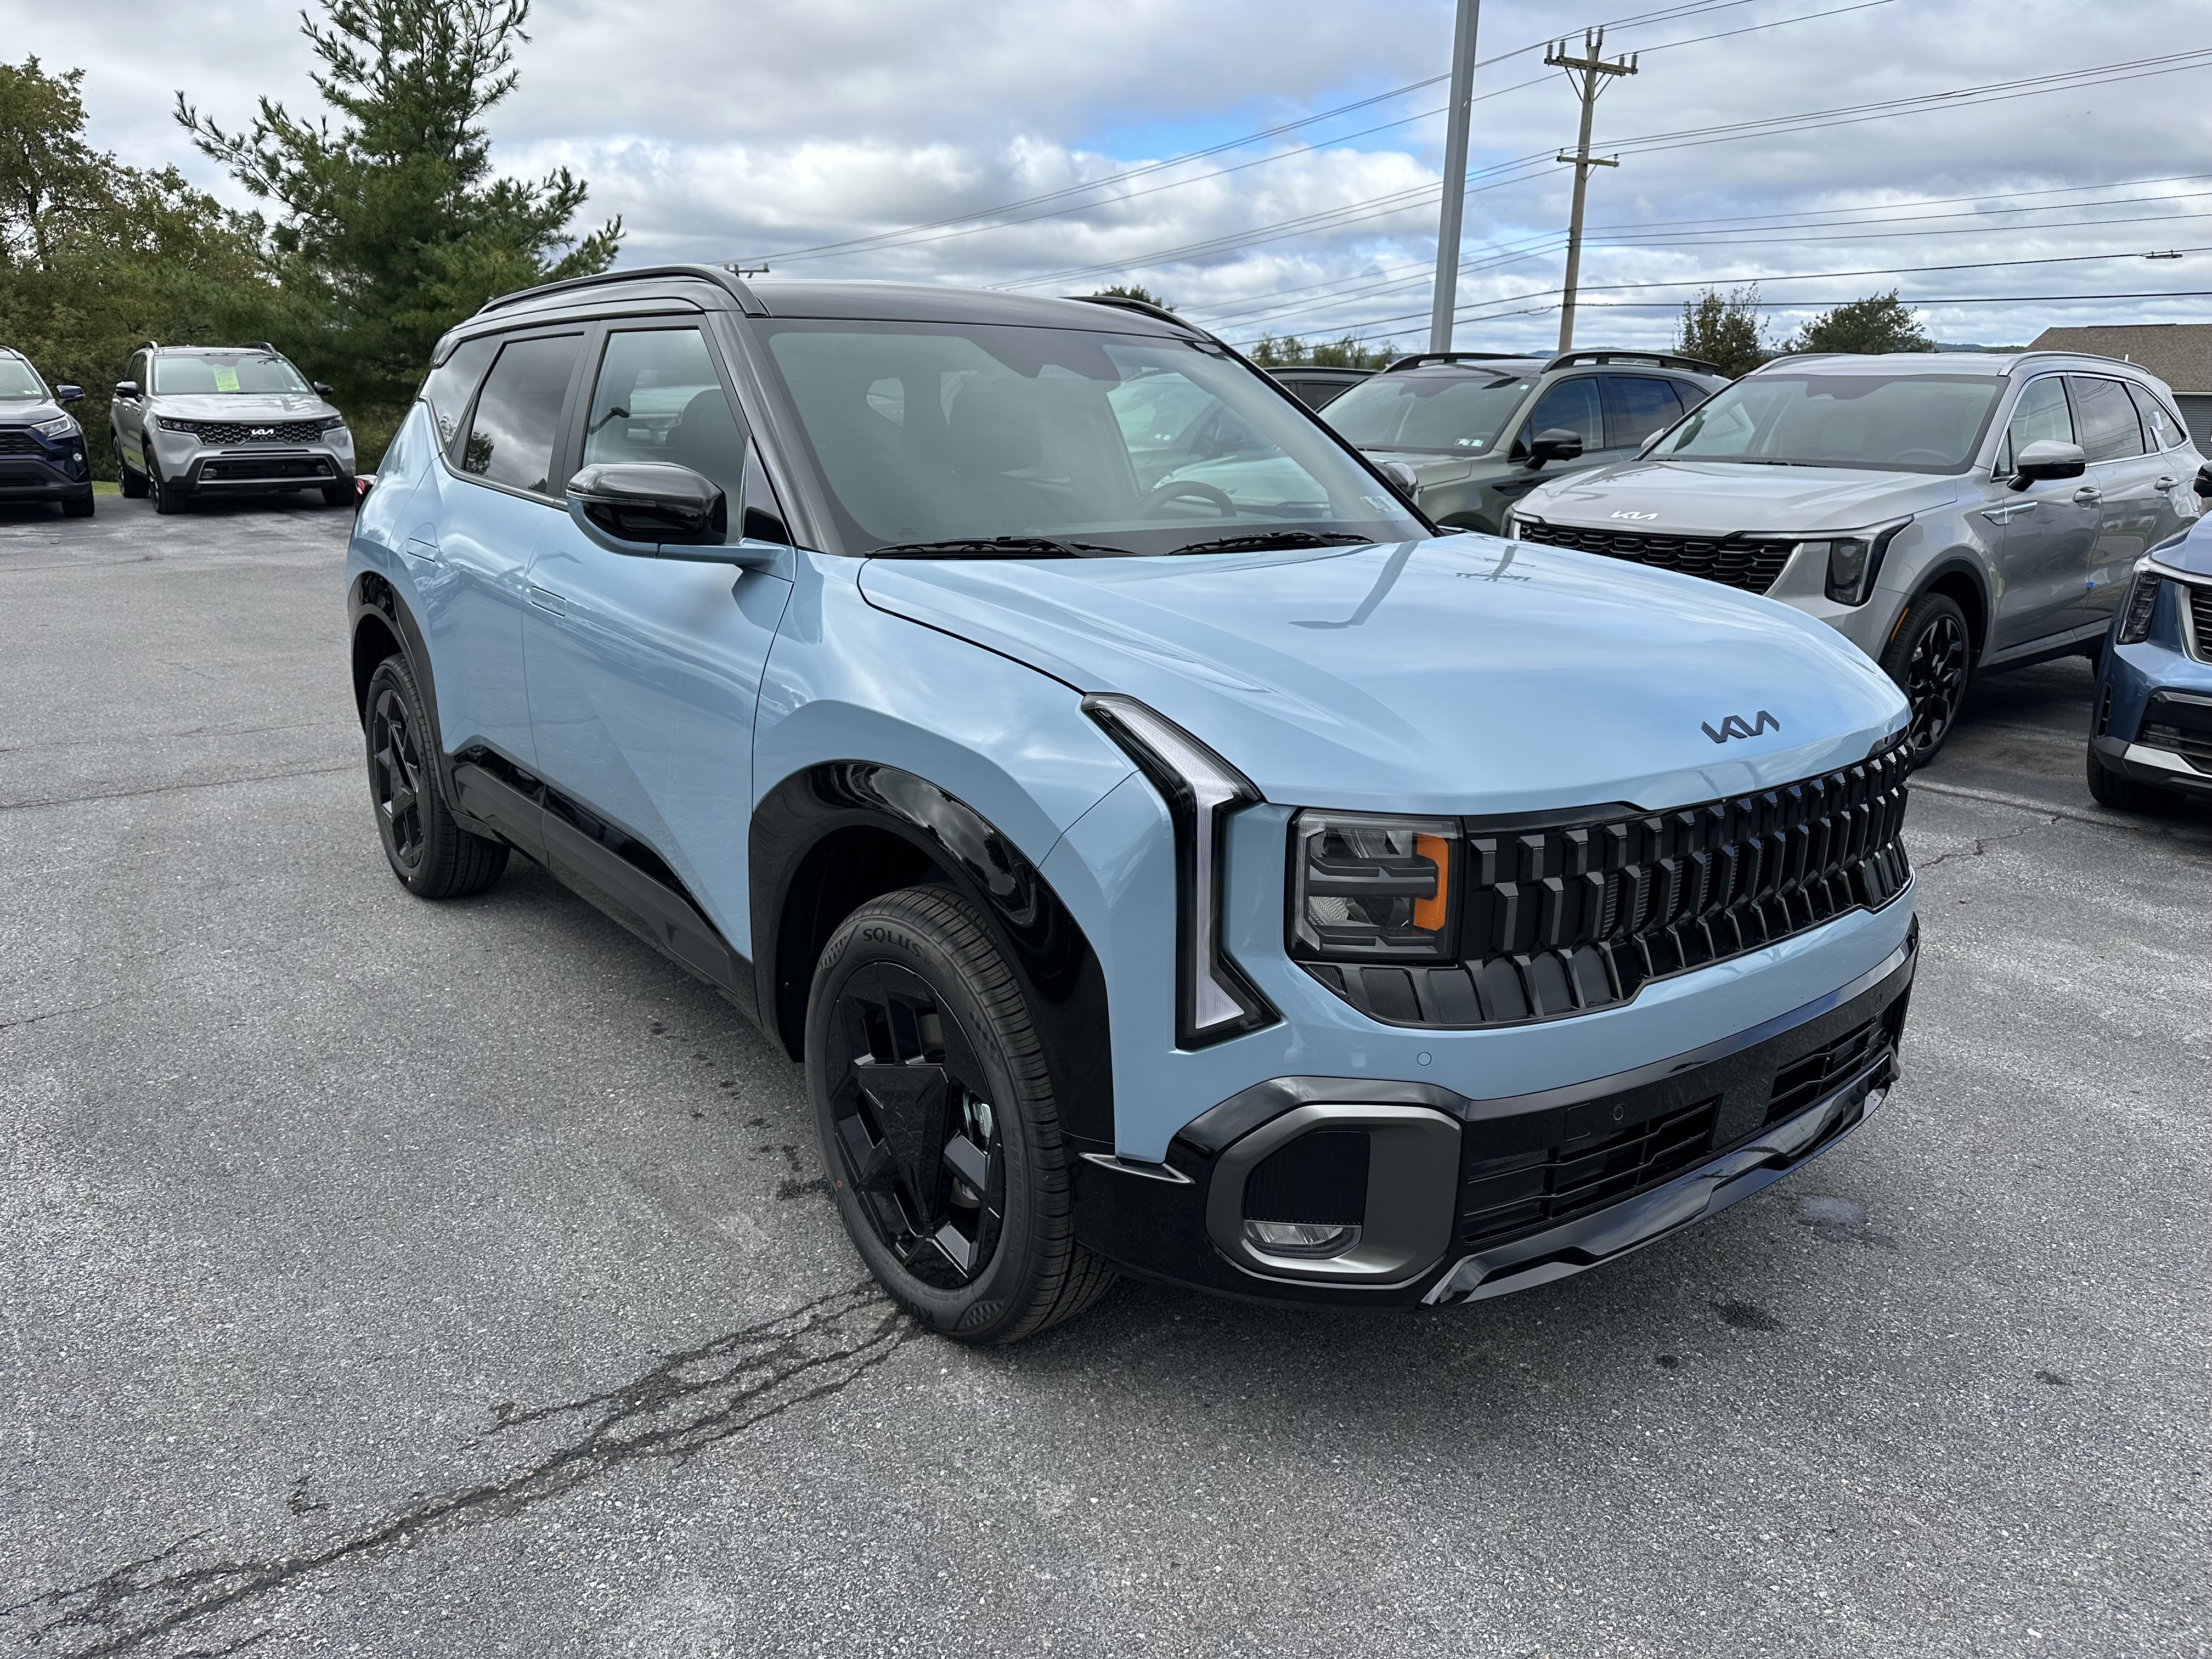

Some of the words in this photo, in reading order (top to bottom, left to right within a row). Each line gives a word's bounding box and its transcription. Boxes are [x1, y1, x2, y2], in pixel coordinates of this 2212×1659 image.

[1611, 510, 1659, 521] KIA
[1701, 710, 1780, 744] KIA
[862, 927, 923, 958] SOLUS
